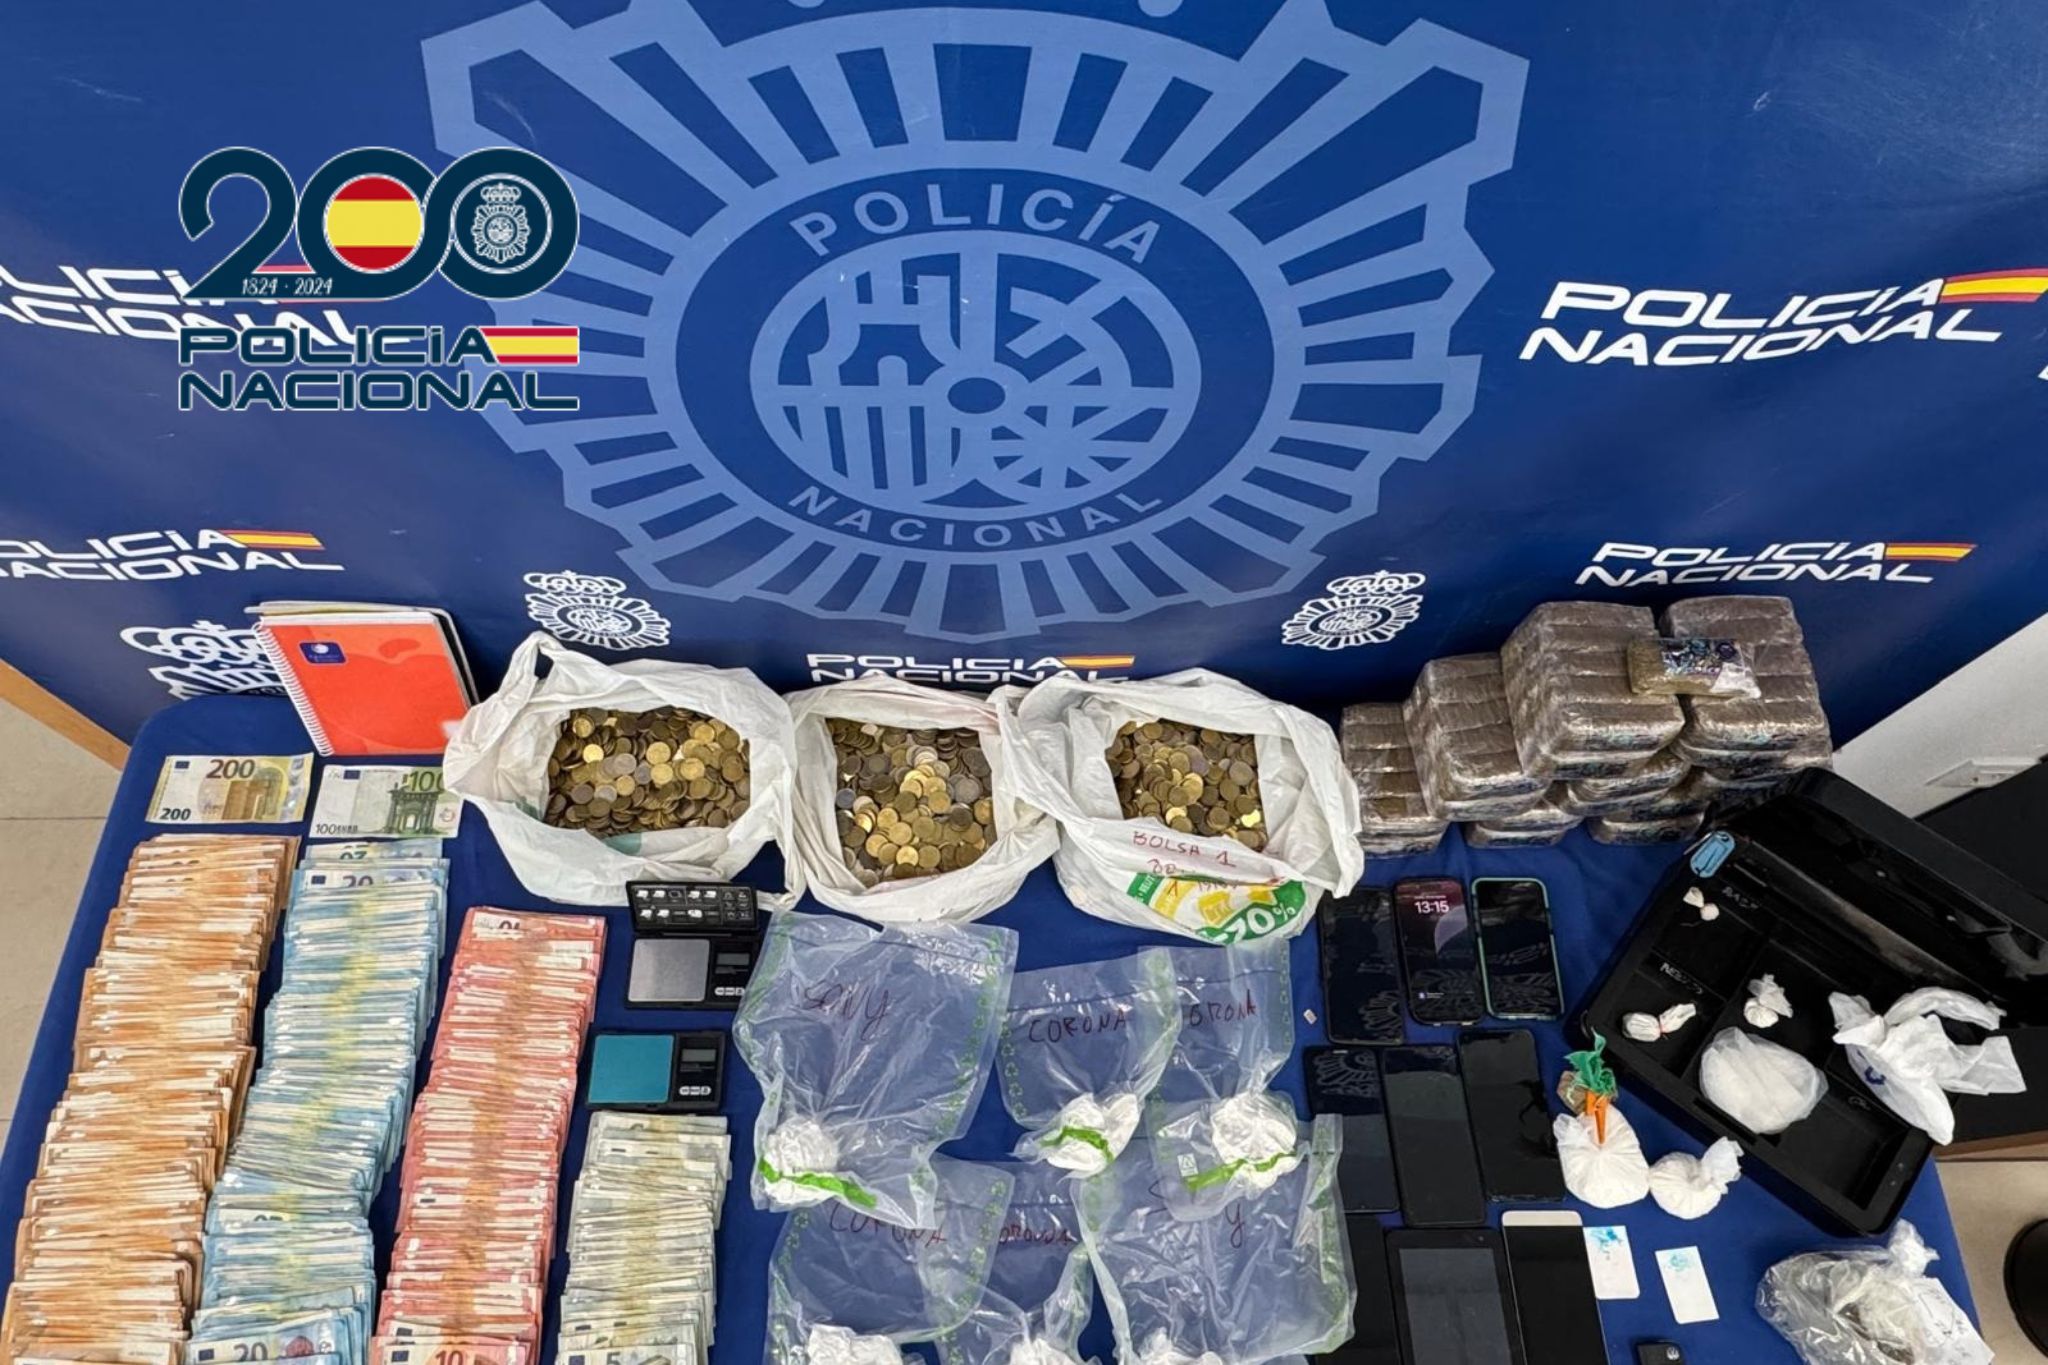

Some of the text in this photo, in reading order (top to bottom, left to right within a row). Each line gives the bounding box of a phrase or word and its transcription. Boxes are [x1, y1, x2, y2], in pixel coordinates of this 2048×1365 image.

[789, 184, 1160, 264] POLICÍA
[1519, 308, 2002, 367] NACIONAL
[788, 484, 1162, 547] NACIONAL
[0, 551, 345, 581] ACIONAL
[1575, 563, 1933, 587] NACIONAL
[206, 759, 256, 779] 200
[159, 807, 192, 821] 200
[315, 823, 336, 835] 100
[1414, 900, 1451, 913] 13:15
[1028, 1008, 1131, 1043] CORONA
[233, 1341, 269, 1361] 20
